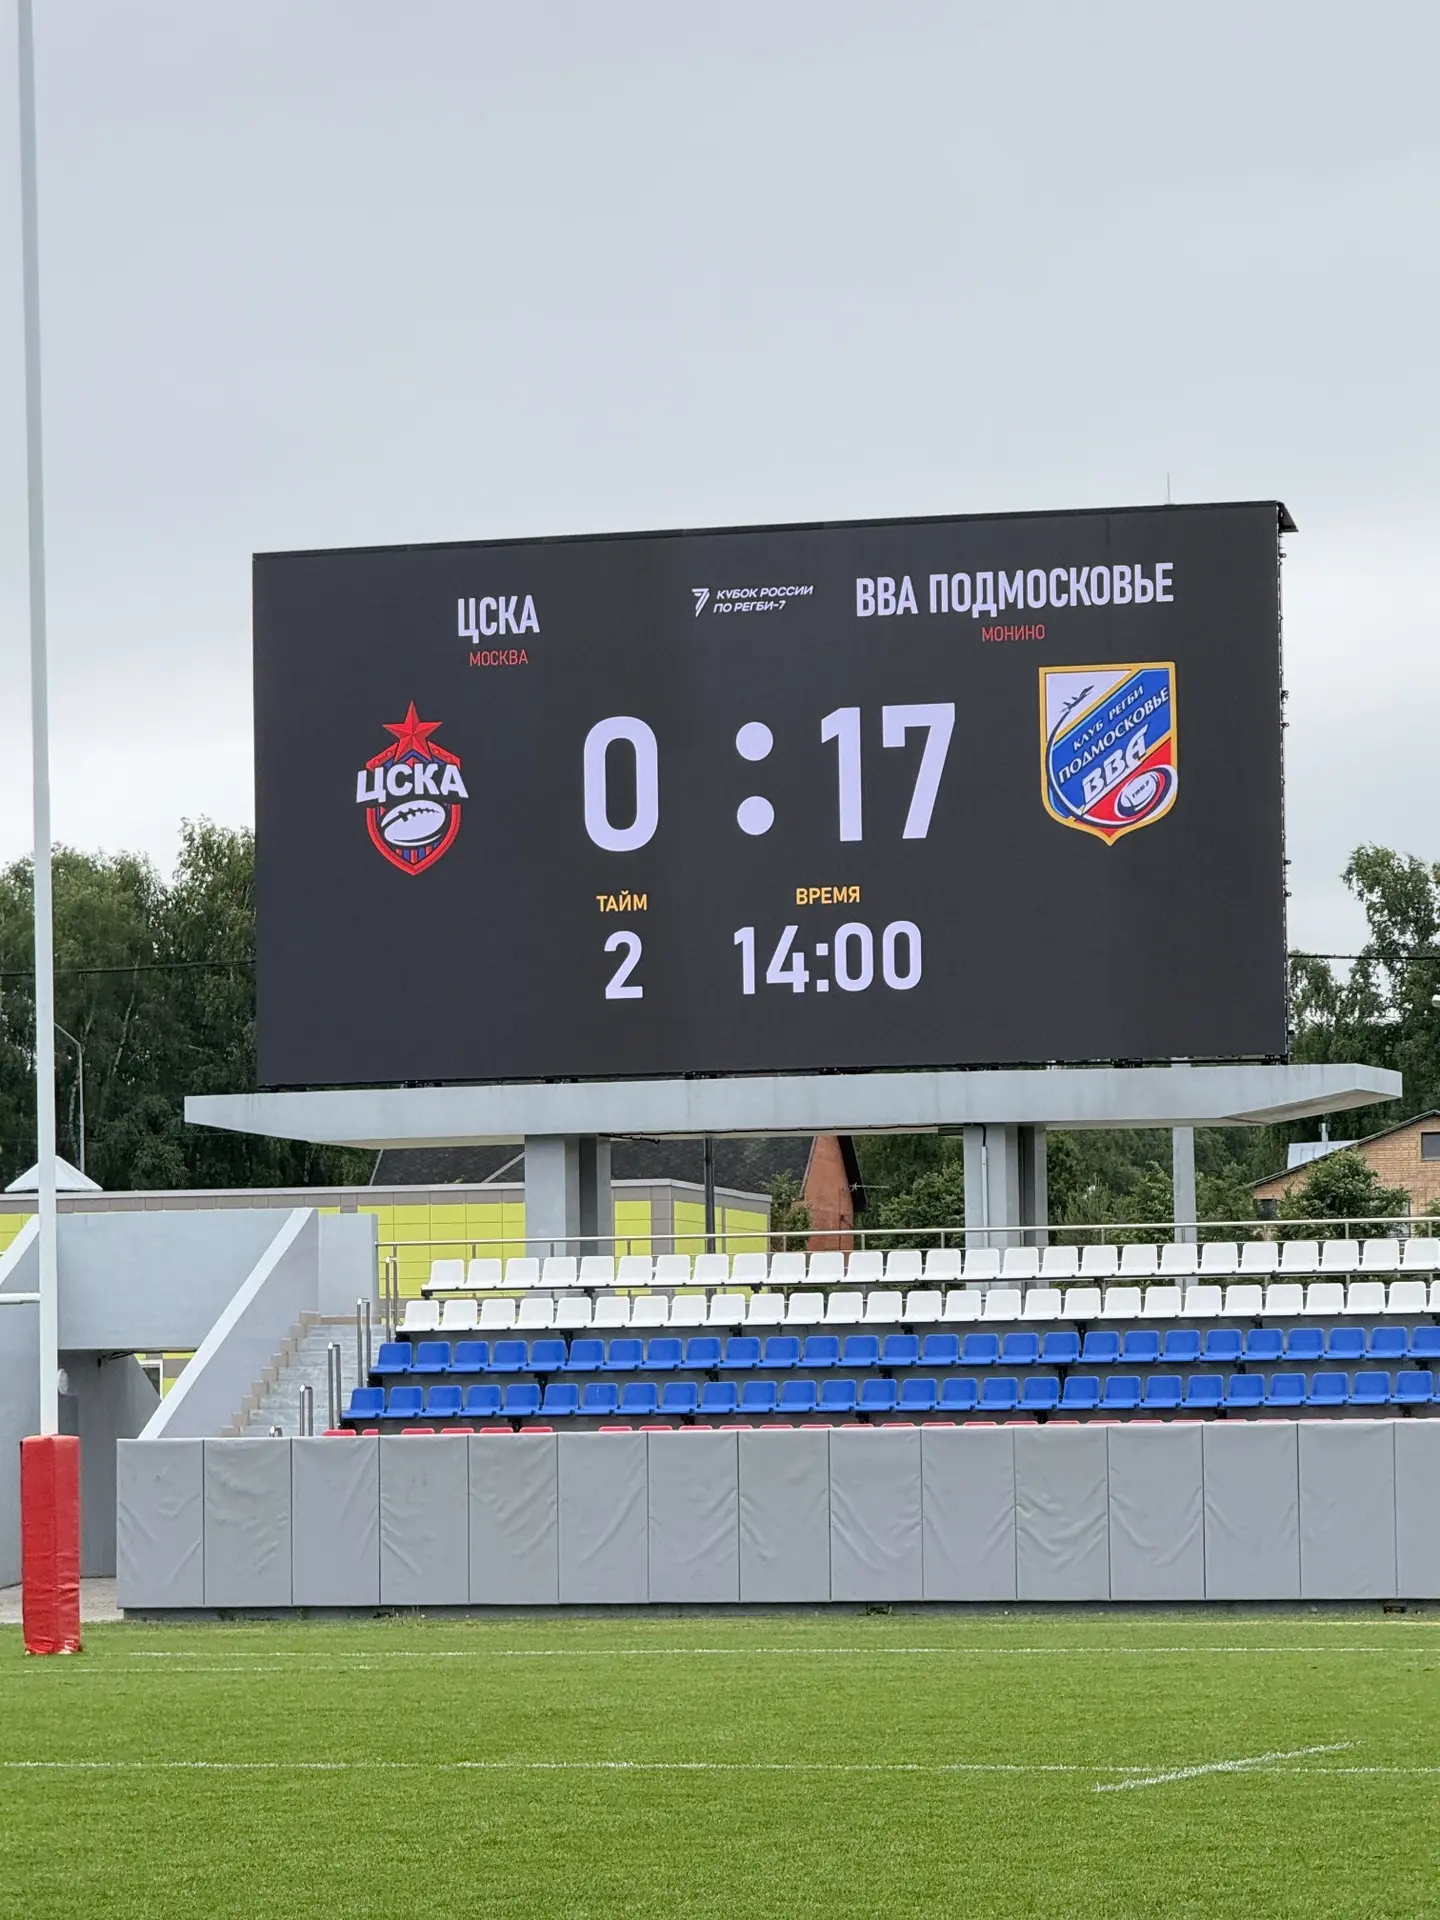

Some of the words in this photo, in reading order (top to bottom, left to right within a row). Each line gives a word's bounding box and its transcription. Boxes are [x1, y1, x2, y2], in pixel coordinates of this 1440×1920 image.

[713, 603, 732, 613] ПО
[734, 600, 786, 612] РЕГБИ-7
[716, 588, 759, 600] КУБОК
[760, 585, 814, 598] РОССИИ
[856, 576, 918, 617] ВВА
[930, 563, 1174, 618] ПОДМОСКОВЬЕ
[457, 595, 541, 644] ЦСКА
[982, 624, 1045, 642] МОНИНО
[469, 649, 529, 667] МОСКВА
[1058, 687, 1170, 783] ПОДМОСКОВЬЕ
[1073, 718, 1105, 752] КЛУБ
[1108, 685, 1144, 720] РЕГБИ
[356, 763, 469, 803] ЦСКА
[584, 716, 659, 852] 0
[821, 703, 956, 842] 17
[1082, 723, 1149, 803] ВВА
[596, 890, 648, 912] ТАЙМ
[796, 886, 861, 906] ВРЕМЯ
[604, 931, 644, 1000] 2
[734, 921, 922, 994] 14:00
